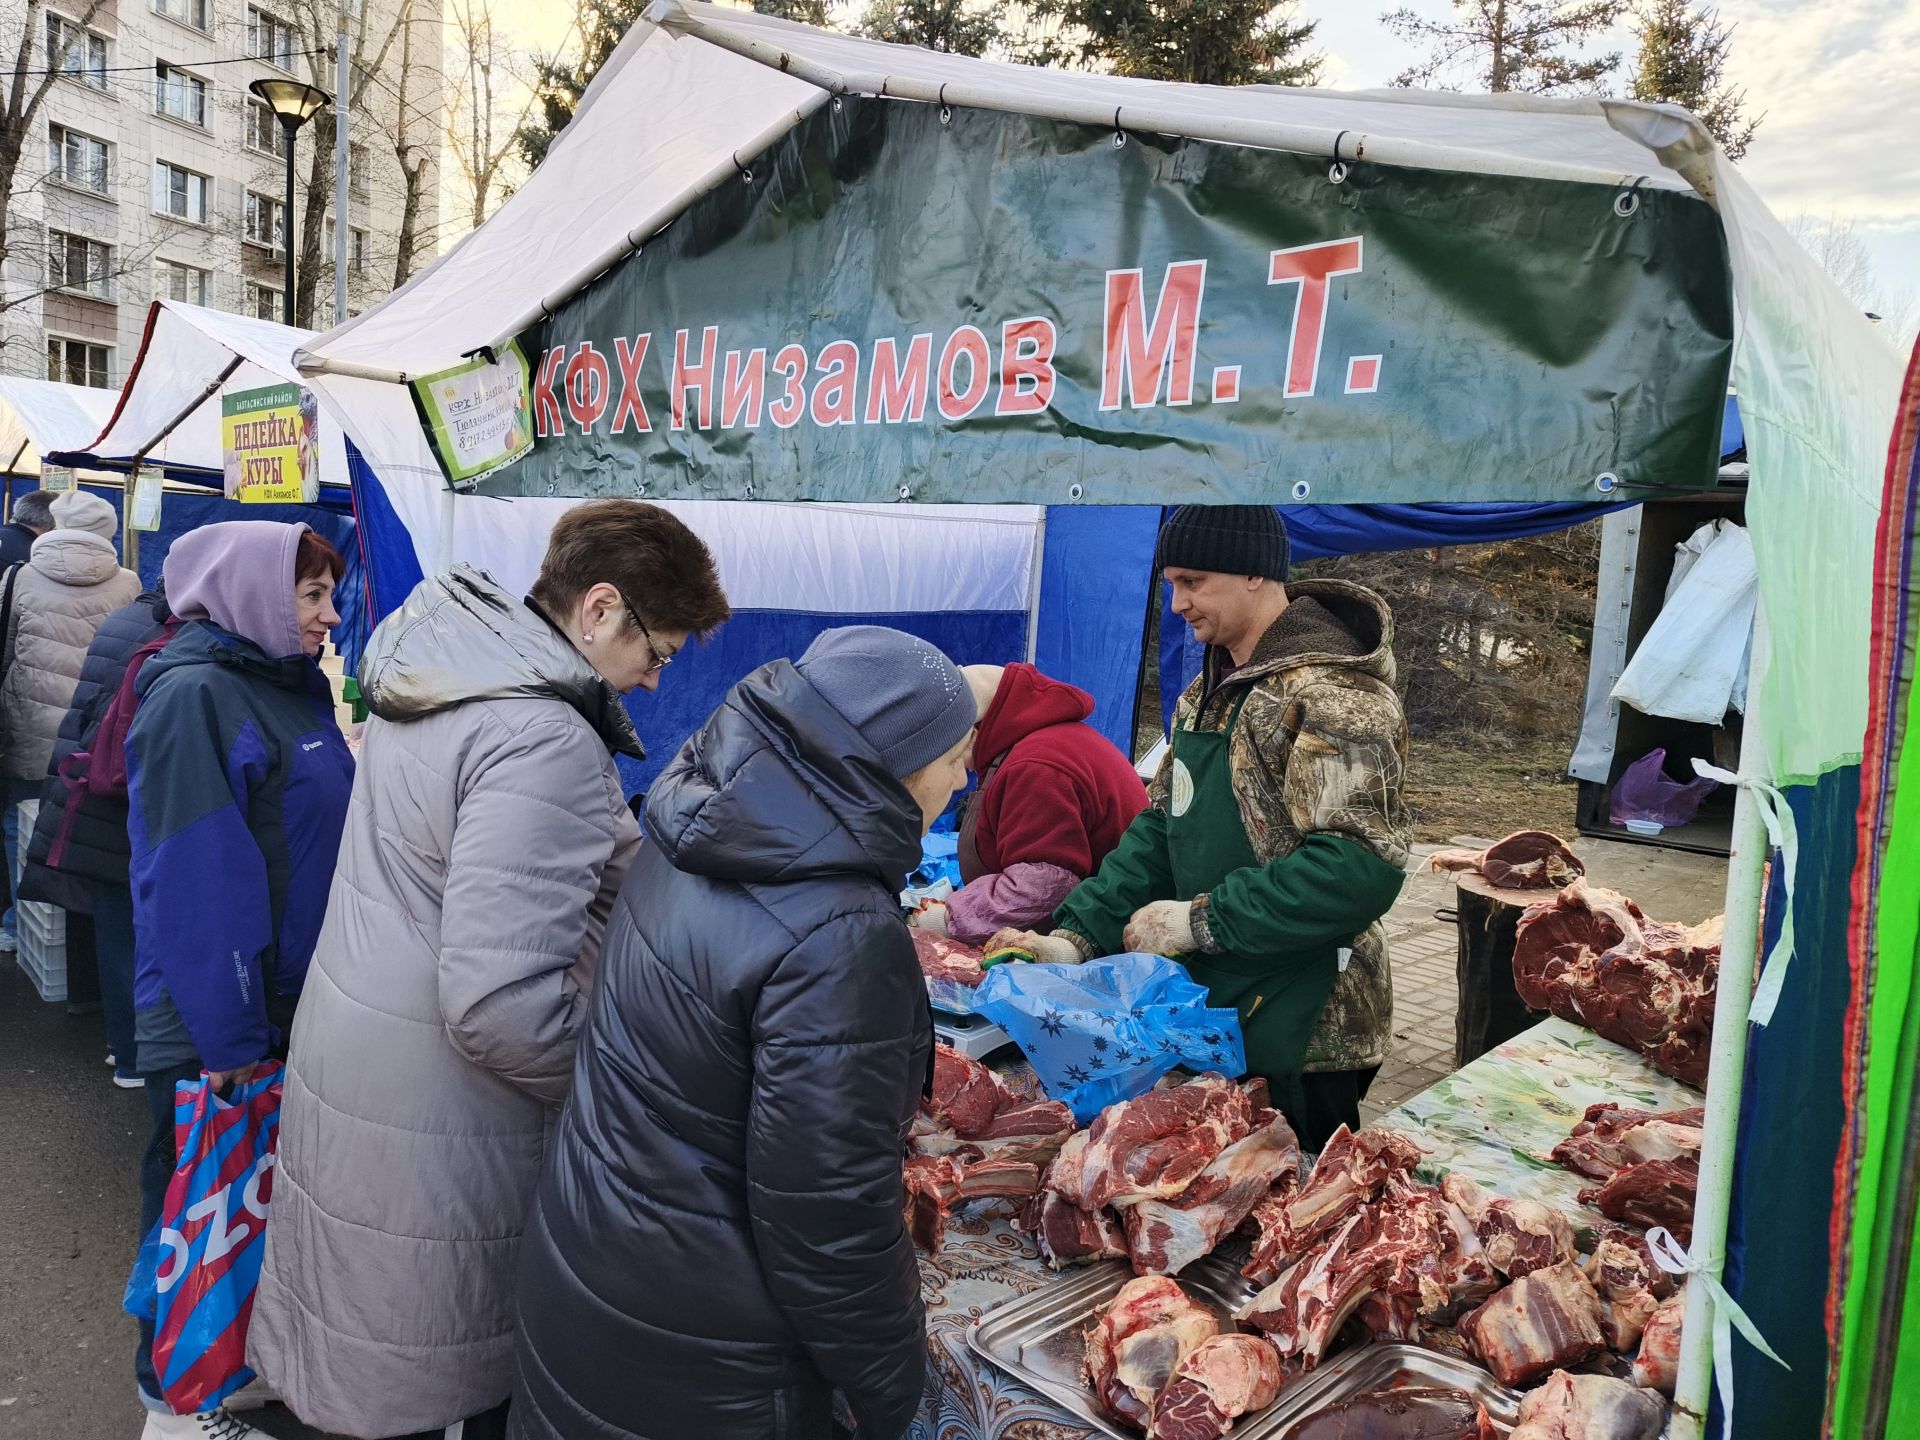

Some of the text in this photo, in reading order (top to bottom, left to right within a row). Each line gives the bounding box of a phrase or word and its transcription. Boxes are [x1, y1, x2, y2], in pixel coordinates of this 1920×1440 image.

[274, 392, 293, 404] РАЙОН
[533, 332, 653, 437] КФХ
[670, 315, 1057, 430] Низамов
[234, 412, 297, 456] ИНДЕЙКА
[246, 456, 283, 485] КУРЫ
[157, 1152, 275, 1293] OZO
